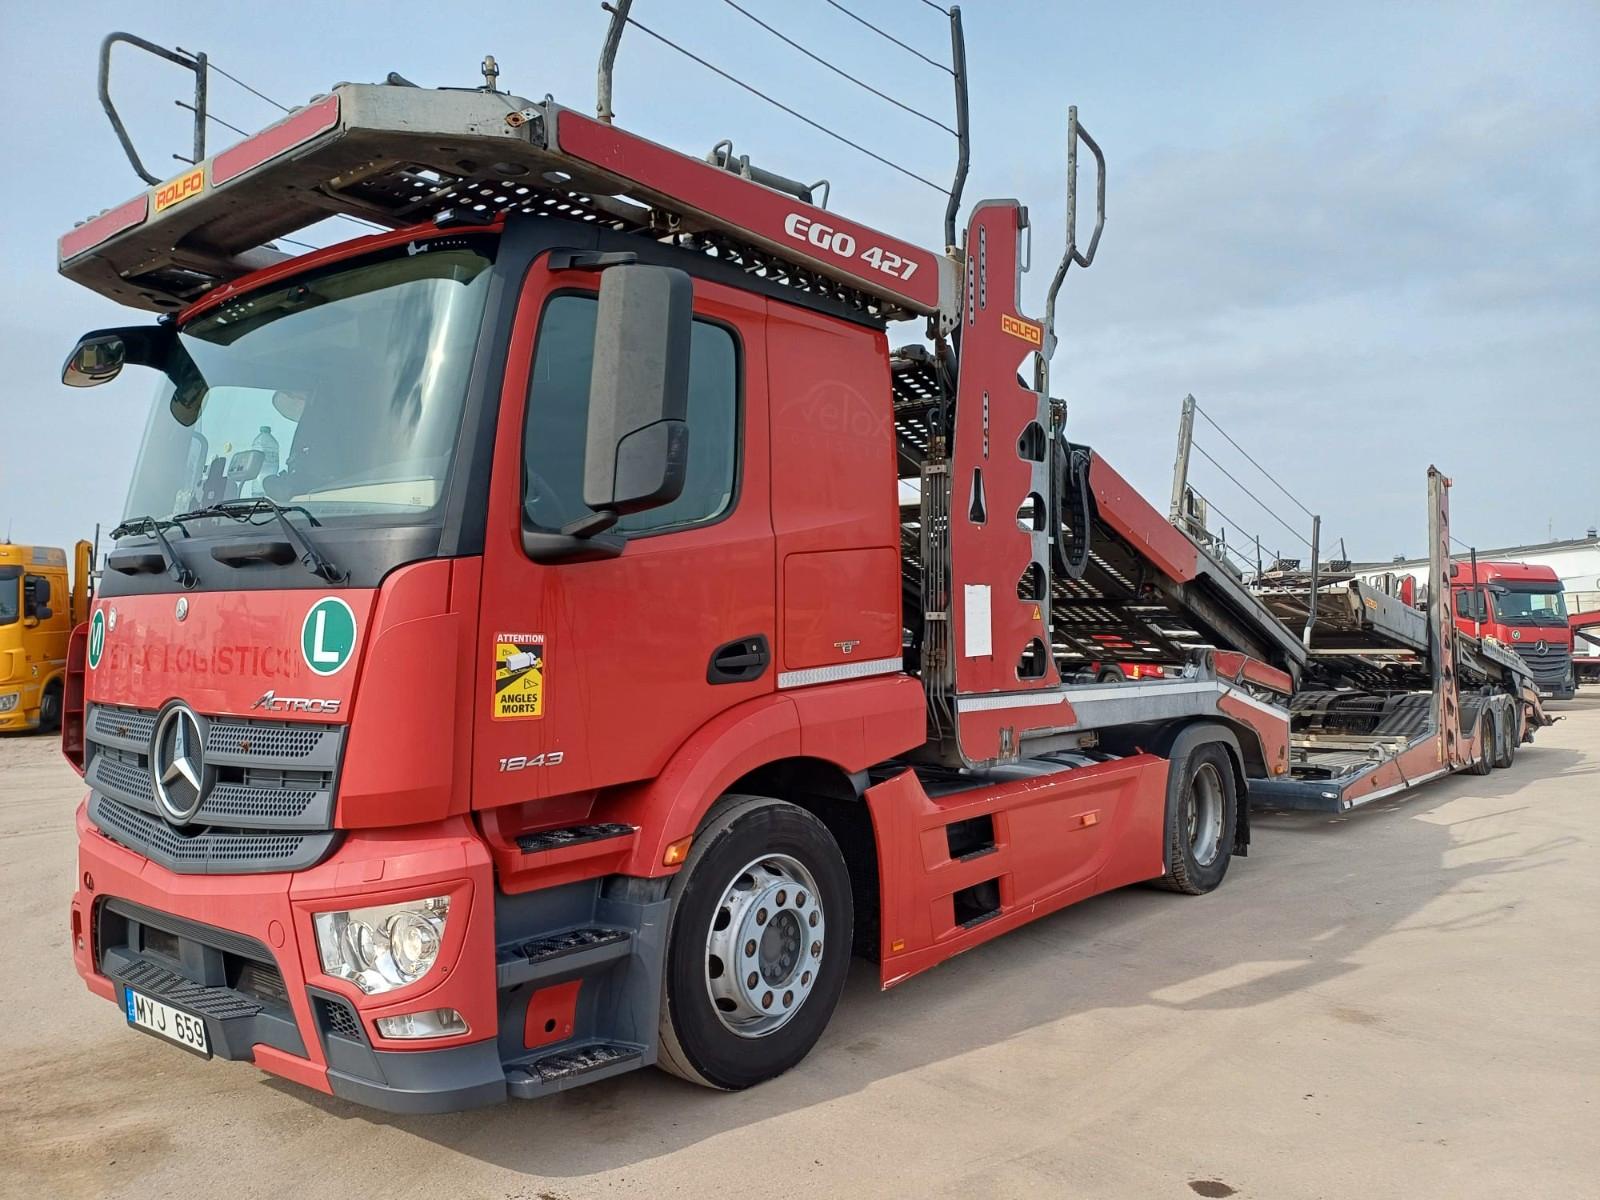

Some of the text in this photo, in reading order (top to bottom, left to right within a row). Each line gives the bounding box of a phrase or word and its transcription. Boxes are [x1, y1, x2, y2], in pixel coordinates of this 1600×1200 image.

[156, 171, 202, 209] ROLFO
[784, 213, 919, 281] EGO 427
[1003, 316, 1039, 342] ROLFO
[312, 610, 339, 662] L
[497, 633, 544, 643] ATTENTION
[500, 693, 538, 704] ANGLES
[501, 703, 536, 714] MORTS
[499, 751, 564, 772] 1843
[135, 995, 205, 1048] MYJ 659
